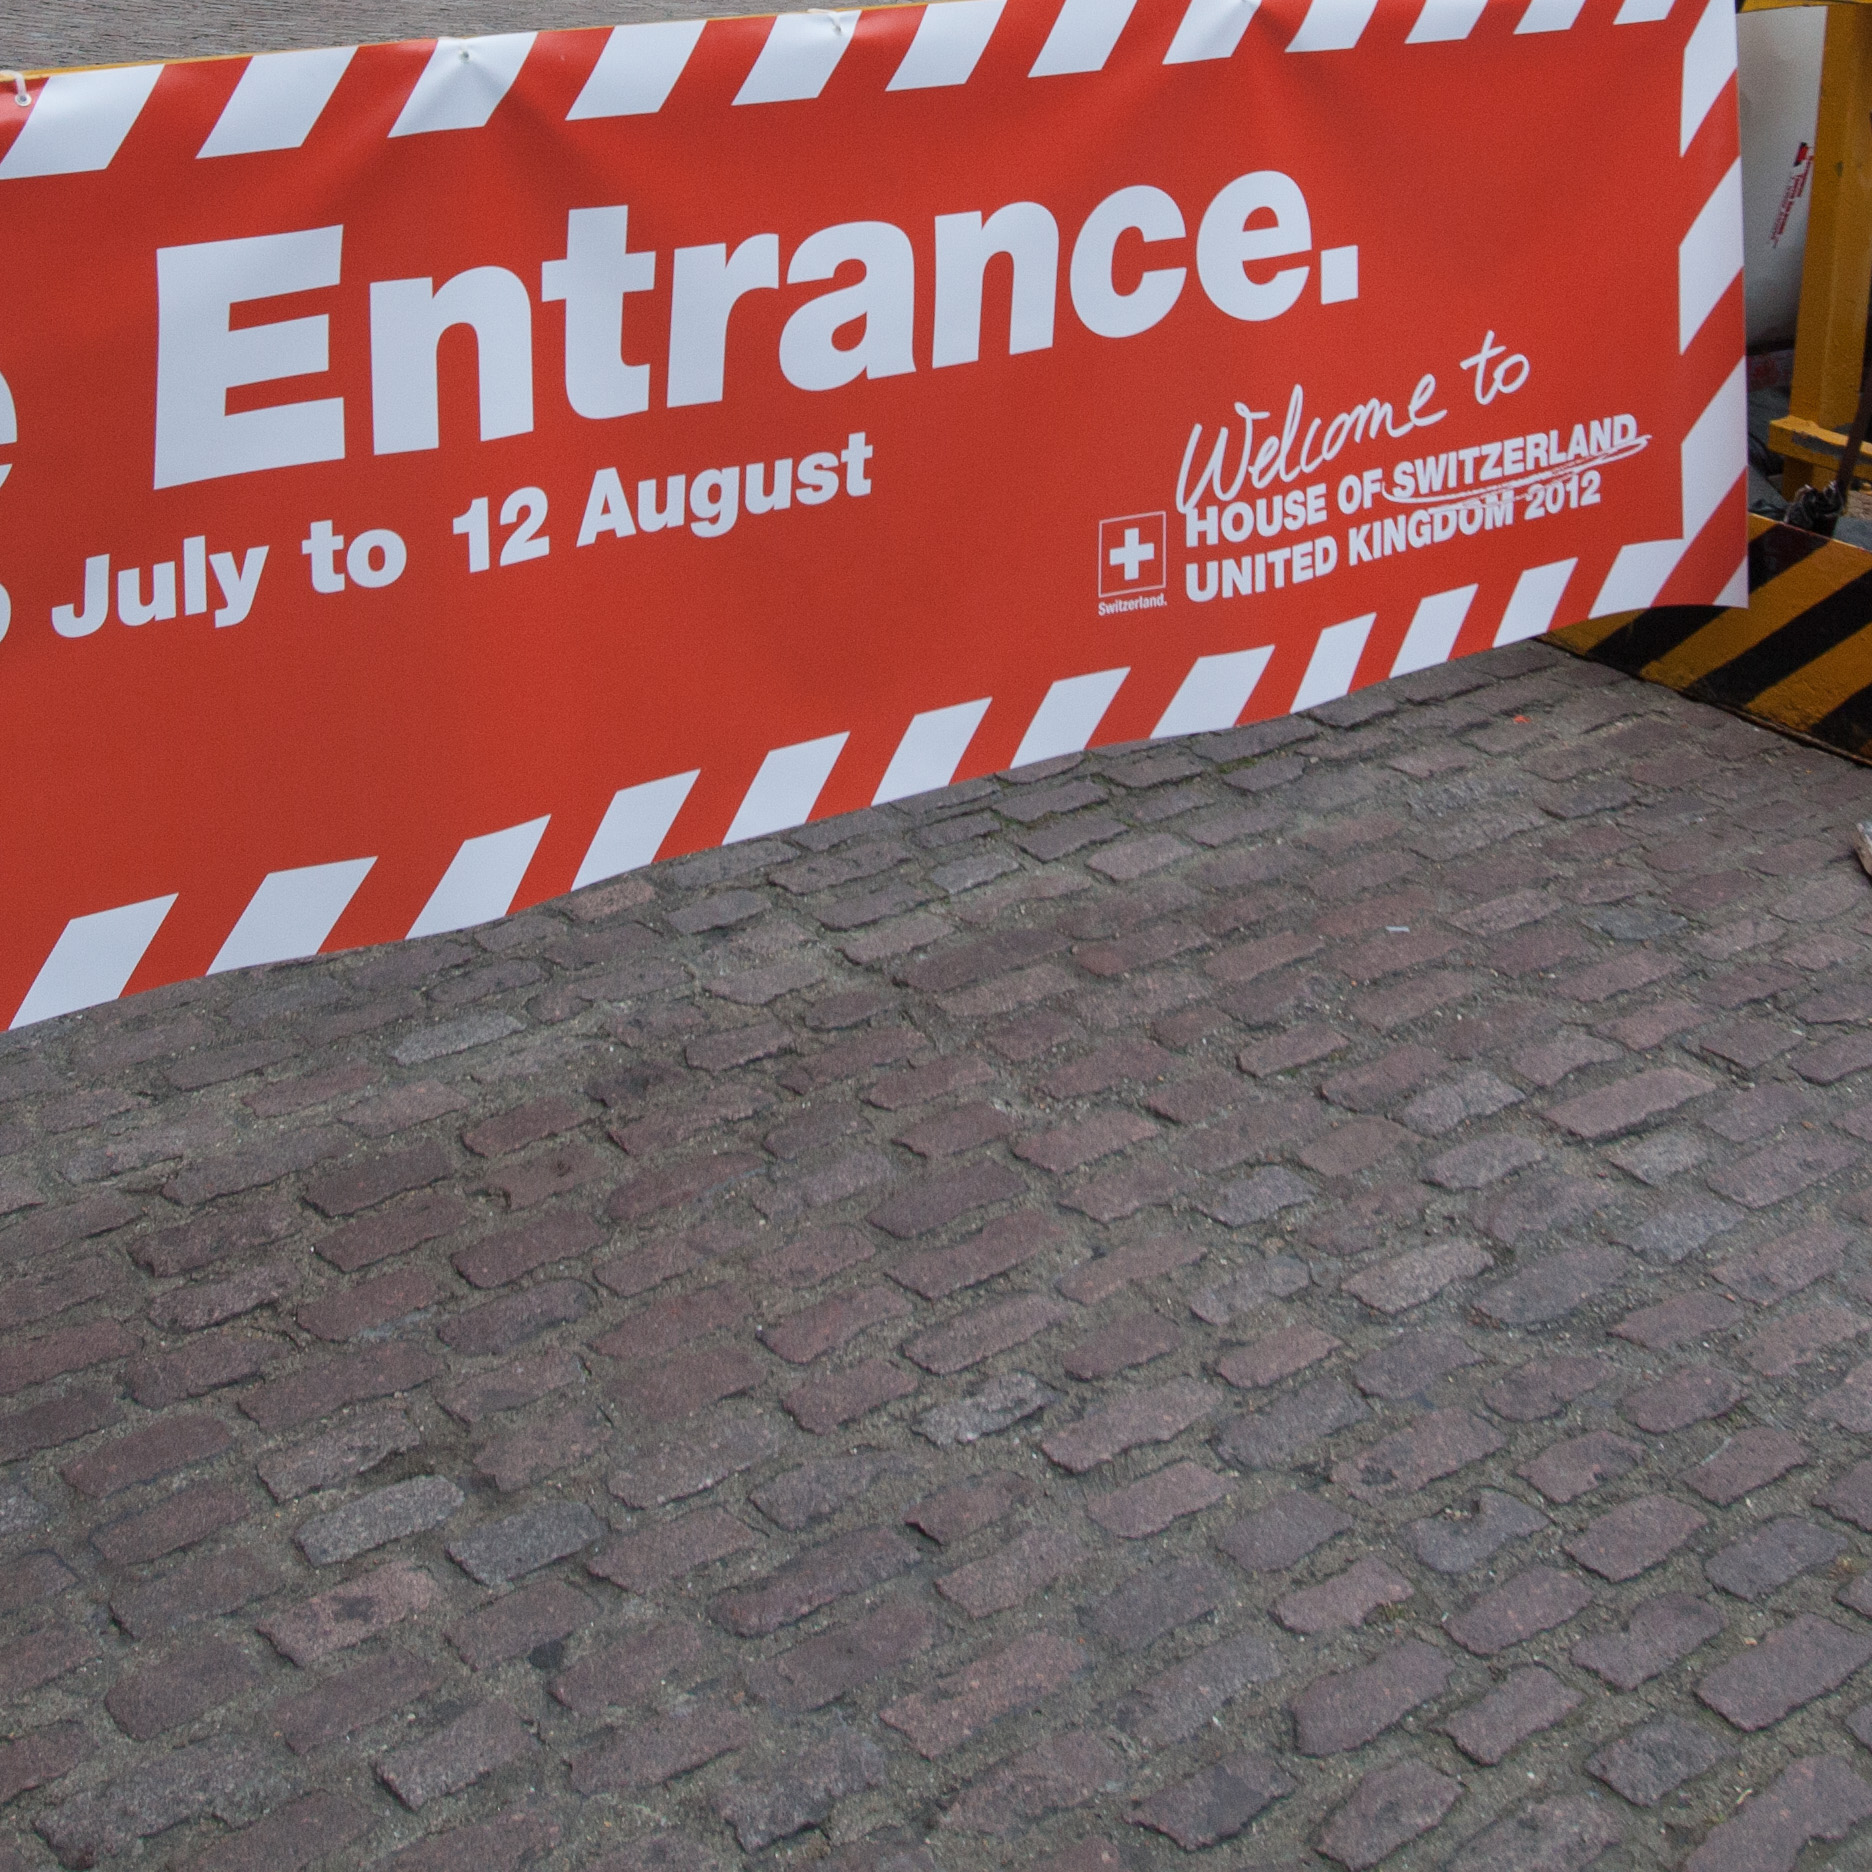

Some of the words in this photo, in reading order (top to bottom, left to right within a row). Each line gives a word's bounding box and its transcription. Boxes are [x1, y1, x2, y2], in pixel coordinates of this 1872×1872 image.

[152, 169, 1360, 491] Entrance.
[1175, 373, 1448, 515] Welcome
[1459, 329, 1530, 406] to
[1185, 482, 1328, 549] HOUSE
[1337, 475, 1383, 516] OF
[1392, 413, 1639, 500] SWITZERLAND
[50, 534, 270, 640] July
[301, 518, 408, 595] to
[452, 485, 552, 575] 12
[575, 430, 875, 550] August
[1098, 592, 1169, 616] Switzerland.
[1185, 535, 1339, 603] UNITED
[1348, 490, 1515, 567] KINGDOM
[1524, 470, 1602, 521] 2012
